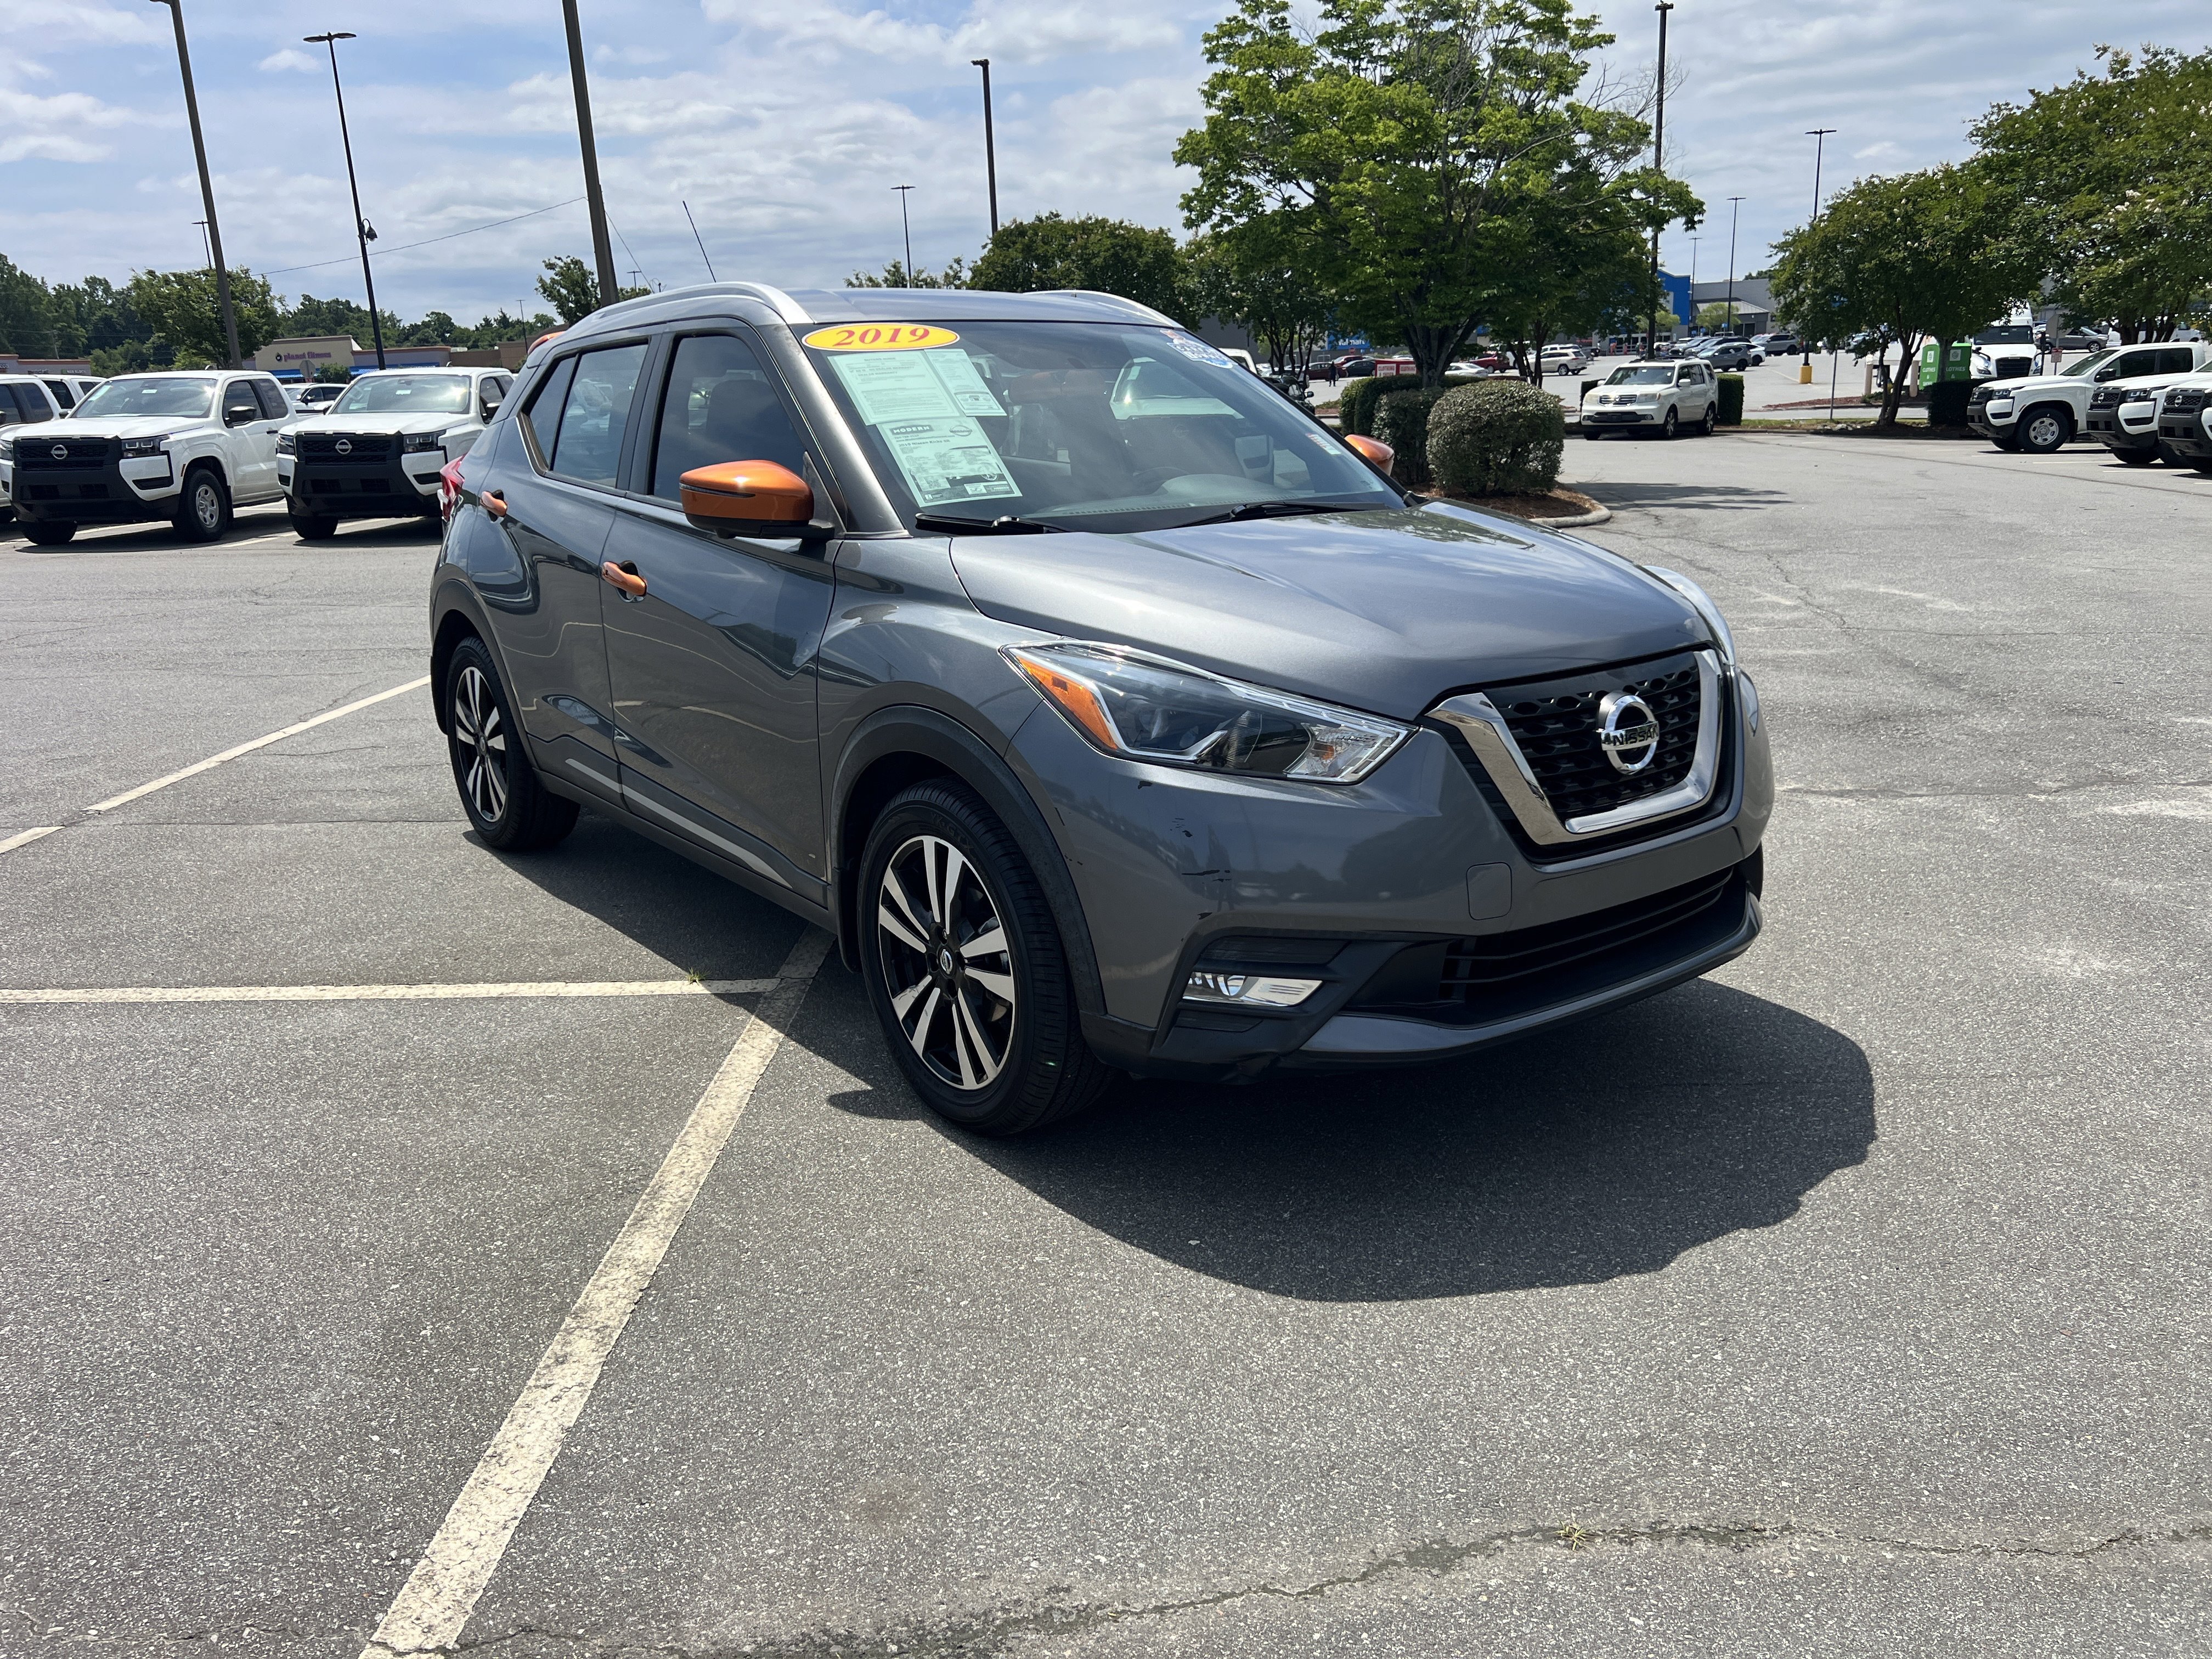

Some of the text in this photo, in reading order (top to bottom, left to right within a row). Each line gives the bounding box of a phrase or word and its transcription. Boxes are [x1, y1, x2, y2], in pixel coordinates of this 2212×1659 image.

[832, 328, 929, 347] 2019
[893, 425, 930, 433] MODERN
[1613, 724, 1658, 746] NISSAN
